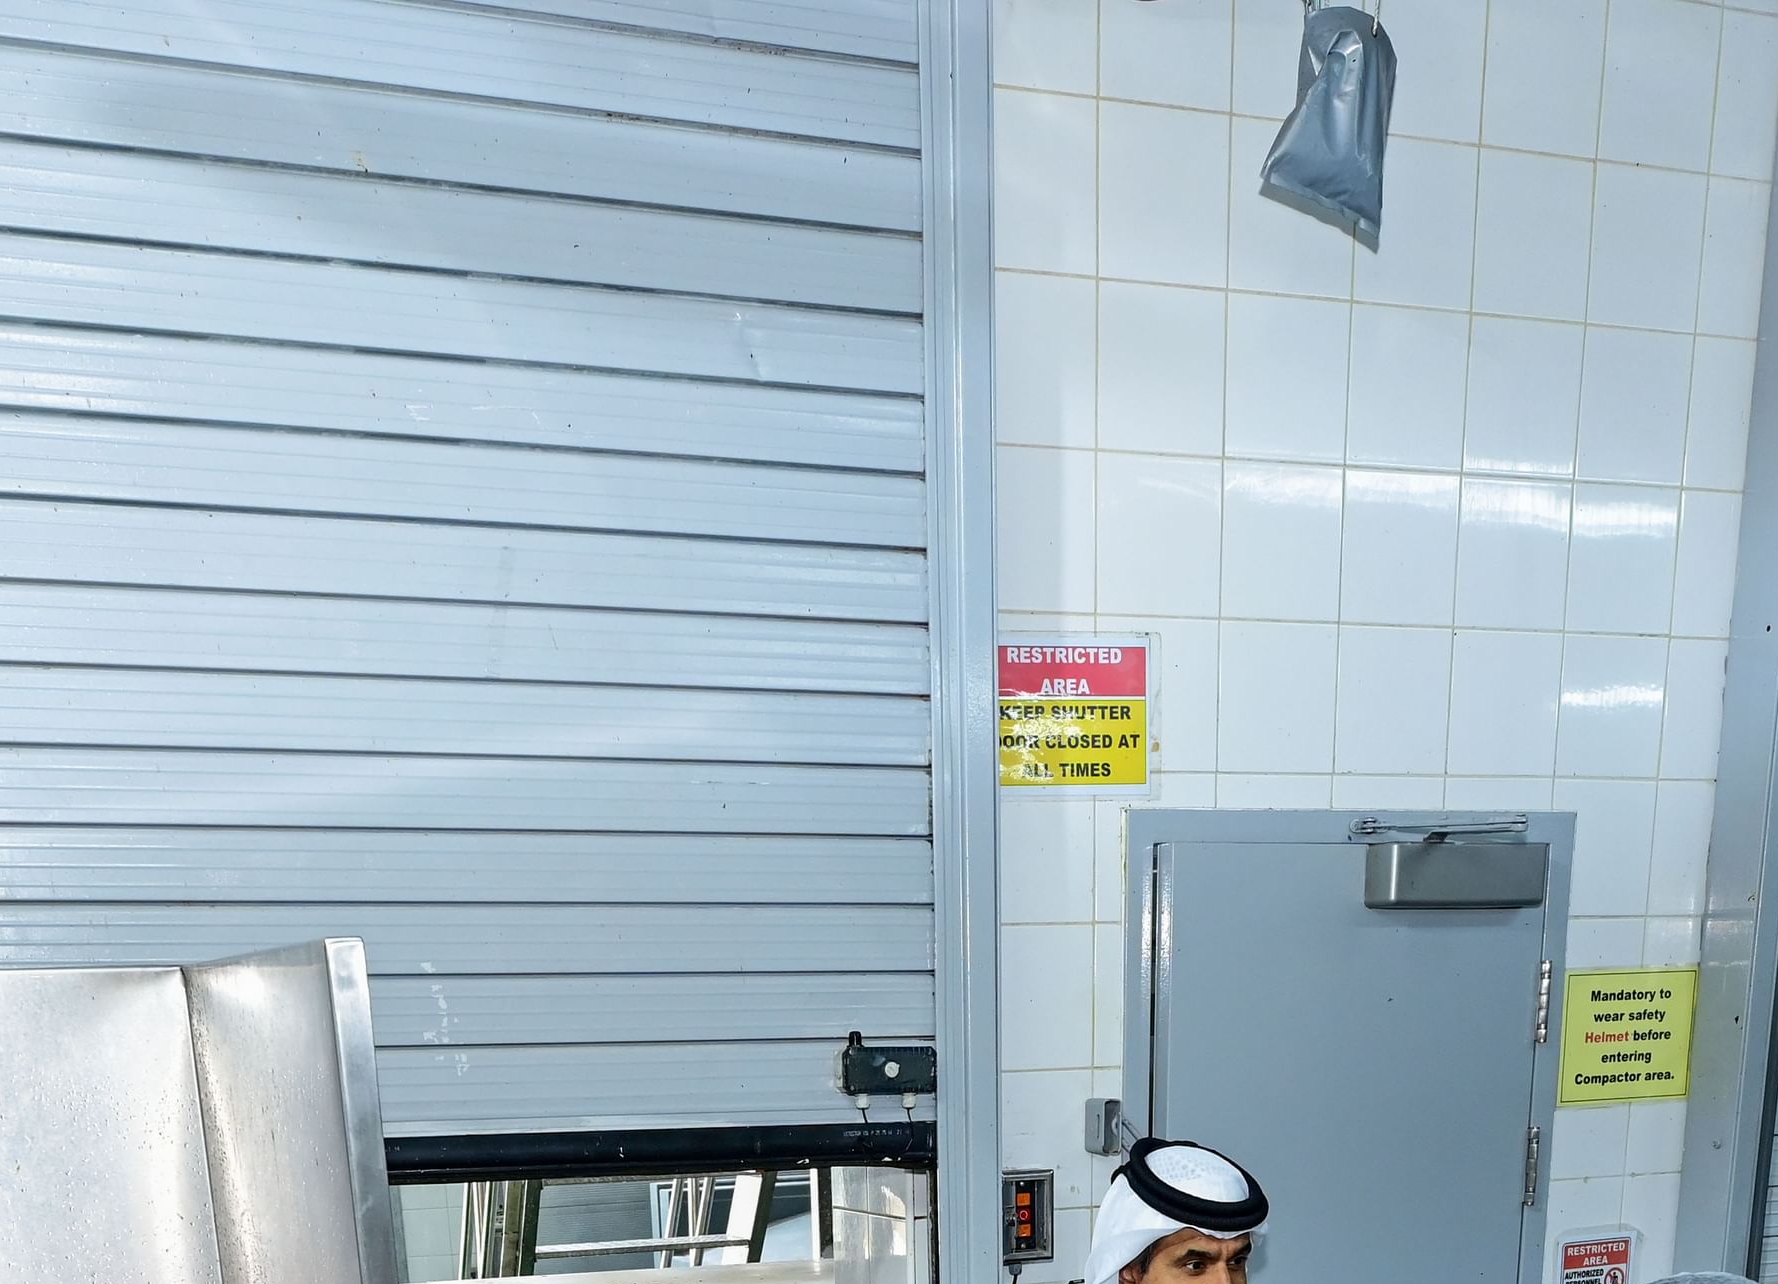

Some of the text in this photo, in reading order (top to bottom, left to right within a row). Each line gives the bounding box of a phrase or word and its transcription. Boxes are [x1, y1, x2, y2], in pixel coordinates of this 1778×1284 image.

[1007, 647, 1122, 664] RESTRICTED
[1040, 678, 1090, 694] AREA
[1051, 705, 1131, 720] SHUTTER
[999, 734, 1140, 749] OOR CLOSED AT
[1059, 762, 1111, 777] TIMES
[1591, 988, 1672, 1003] Mandatory to
[1594, 1009, 1666, 1023] wear safety
[1585, 1029, 1671, 1043] Helmet before
[1601, 1050, 1652, 1064] entering
[1574, 1071, 1674, 1086] Compactor area.
[1567, 1242, 1626, 1257] RESTRICTED
[1583, 1256, 1608, 1266] AREA
[1565, 1268, 1604, 1280] AUTHORIZED
